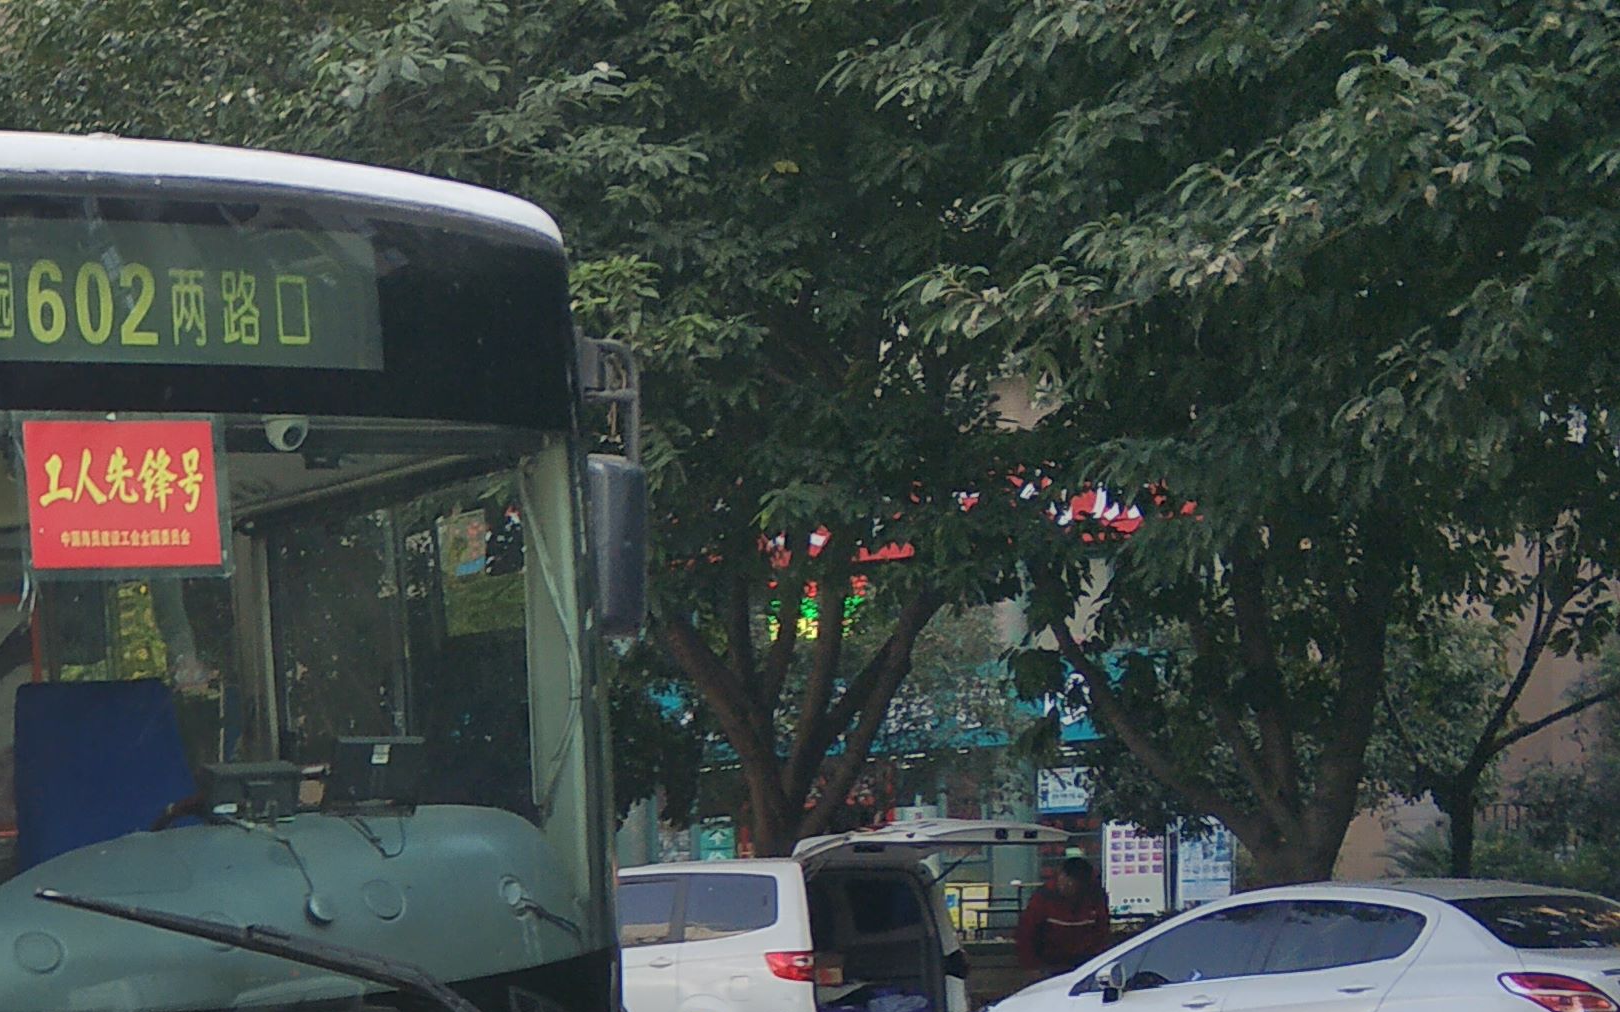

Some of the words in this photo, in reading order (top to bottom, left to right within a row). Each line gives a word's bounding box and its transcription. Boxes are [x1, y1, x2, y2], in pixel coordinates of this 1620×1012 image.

[27, 260, 159, 345] 602
[169, 268, 312, 346] 两路口
[40, 447, 203, 512] 工人先锋号
